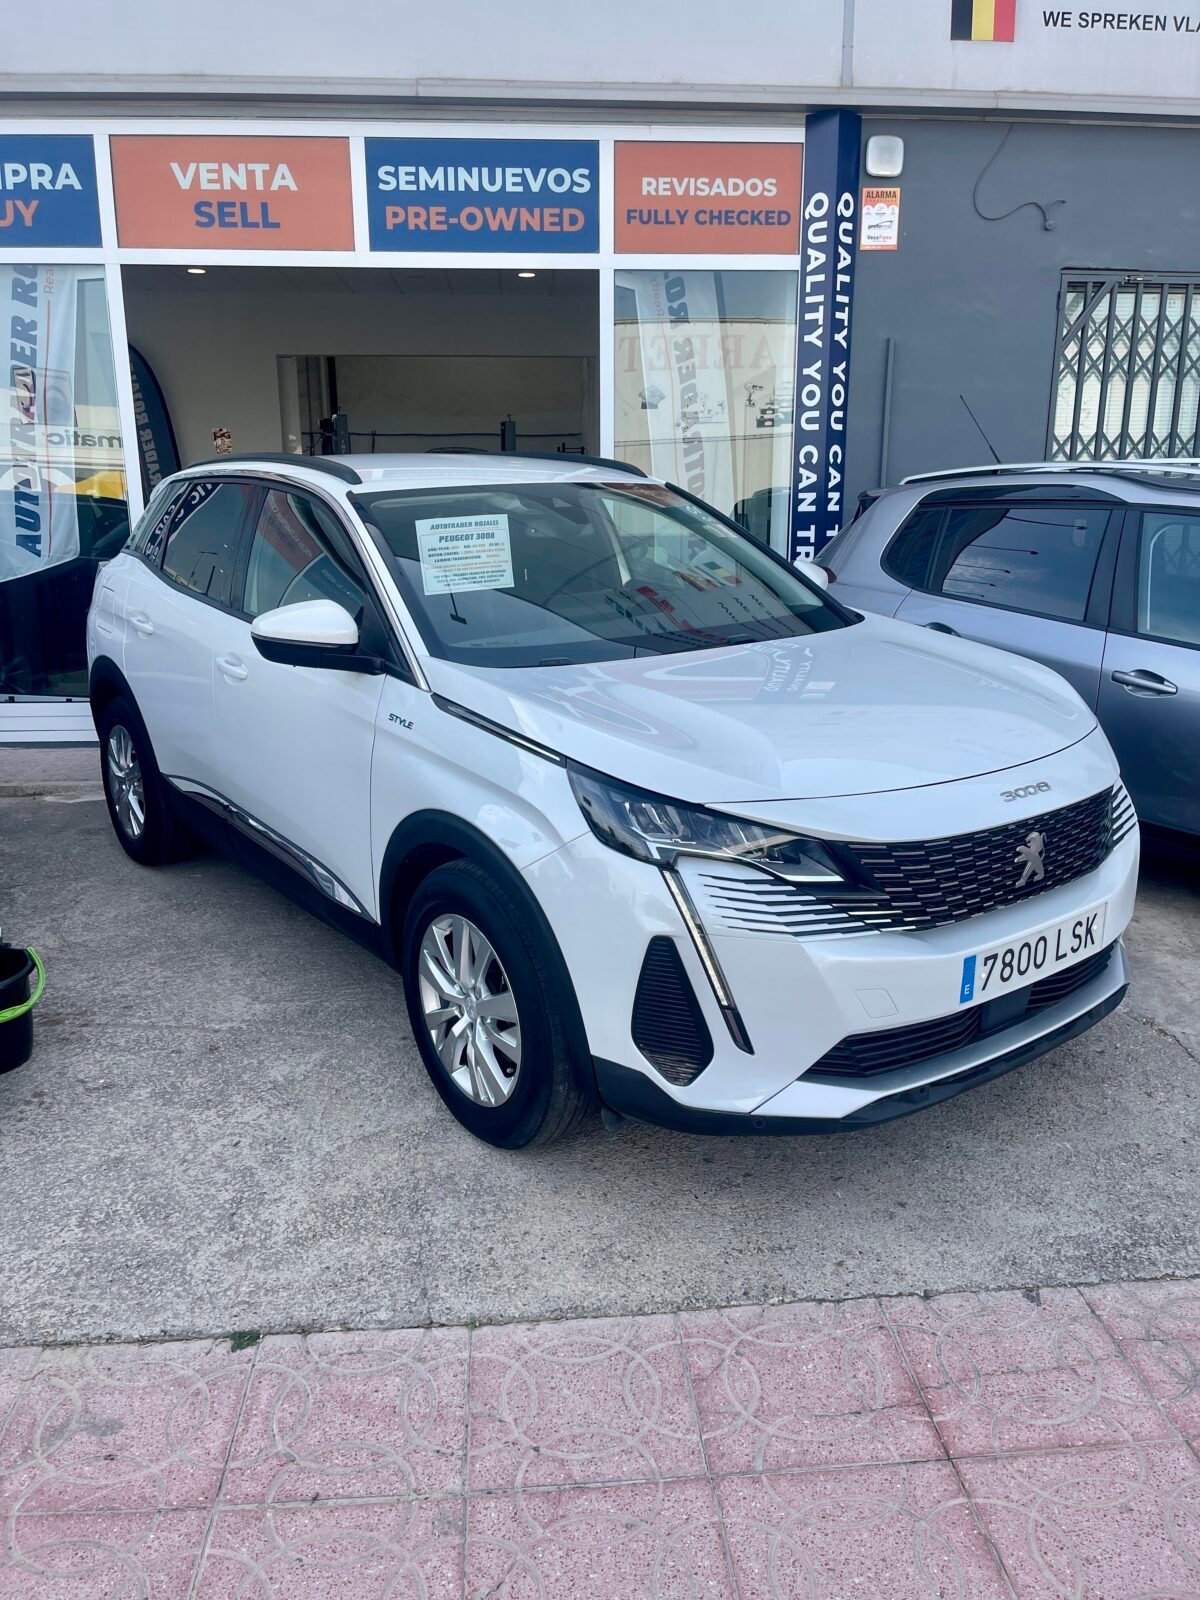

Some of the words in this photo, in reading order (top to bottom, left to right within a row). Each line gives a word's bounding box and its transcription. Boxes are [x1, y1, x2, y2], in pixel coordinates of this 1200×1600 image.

[1043, 11, 1072, 28] WE
[1078, 12, 1167, 32] SPREKEN
[0, 163, 83, 191] PRA
[170, 162, 298, 191] VENTA
[377, 165, 591, 194] SEMINUEVOS
[641, 177, 777, 197] REVISADOS
[866, 191, 897, 199] ALARMA
[194, 201, 281, 228] SELL
[385, 206, 585, 232] PRE-OWNED
[626, 209, 689, 225] FULLY
[694, 209, 792, 226] CHECKED
[804, 192, 829, 348] QUALITY
[834, 192, 855, 349] QUALITY
[800, 360, 822, 431] YOU
[830, 360, 846, 431] YOU
[798, 444, 818, 512] CAN
[827, 444, 842, 511] CAN
[430, 521, 473, 531] AUTOTRADER
[474, 519, 499, 527] ROJALES
[439, 533, 475, 543] PEUGEOT
[476, 532, 495, 540] 3008
[388, 713, 414, 730] STYLE
[1000, 781, 1051, 803] 3008
[981, 935, 1047, 992] 7800
[1055, 912, 1098, 962] LSK
